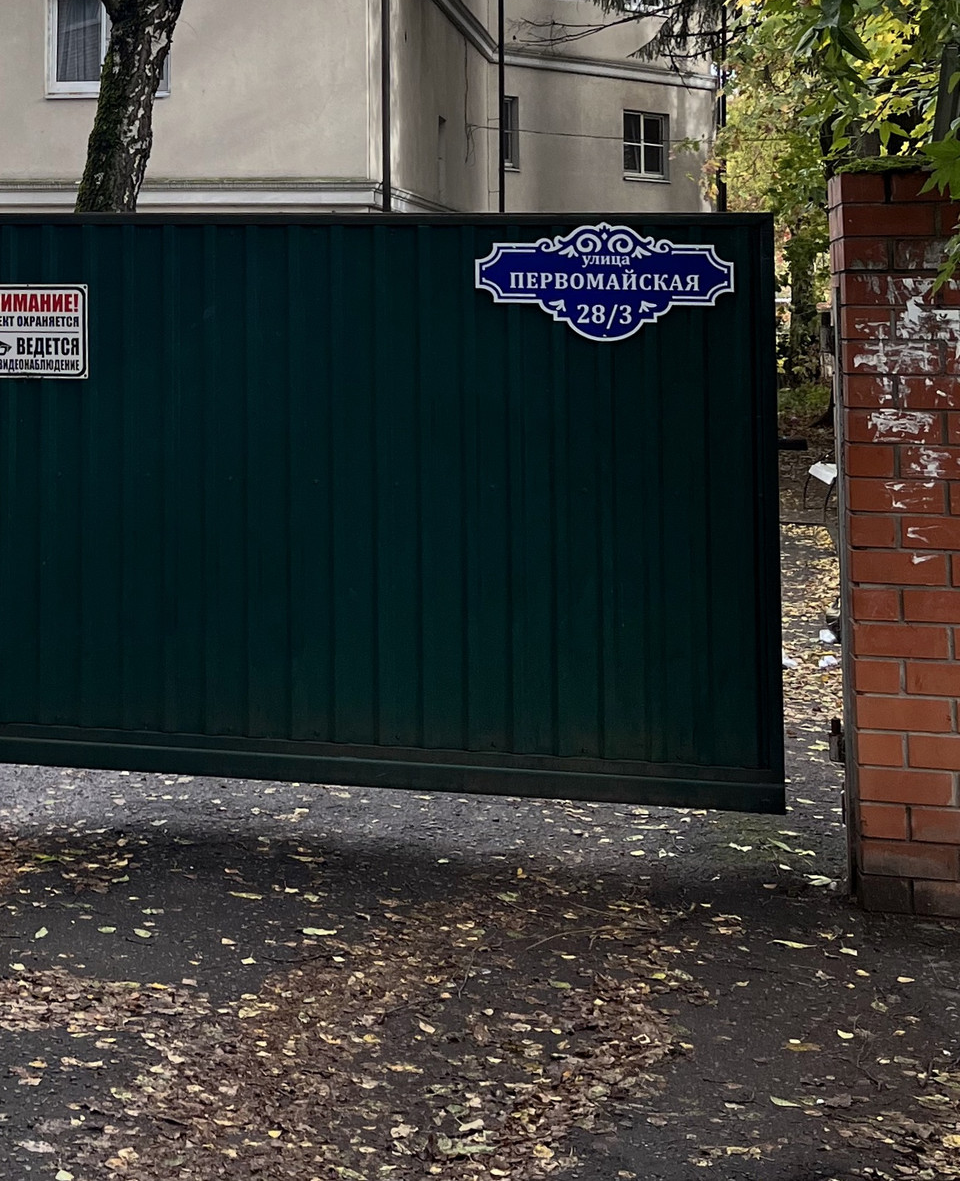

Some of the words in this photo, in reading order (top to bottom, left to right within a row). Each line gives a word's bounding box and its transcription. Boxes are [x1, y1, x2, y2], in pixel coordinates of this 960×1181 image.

[582, 255, 631, 267] улица
[509, 269, 700, 291] ПЕРВОМАЙСКАЯ
[17, 315, 79, 327] ОХРАНЯЕТСЯ
[577, 304, 632, 329] 28/3
[16, 337, 79, 358] ВЕДЕТСЯ
